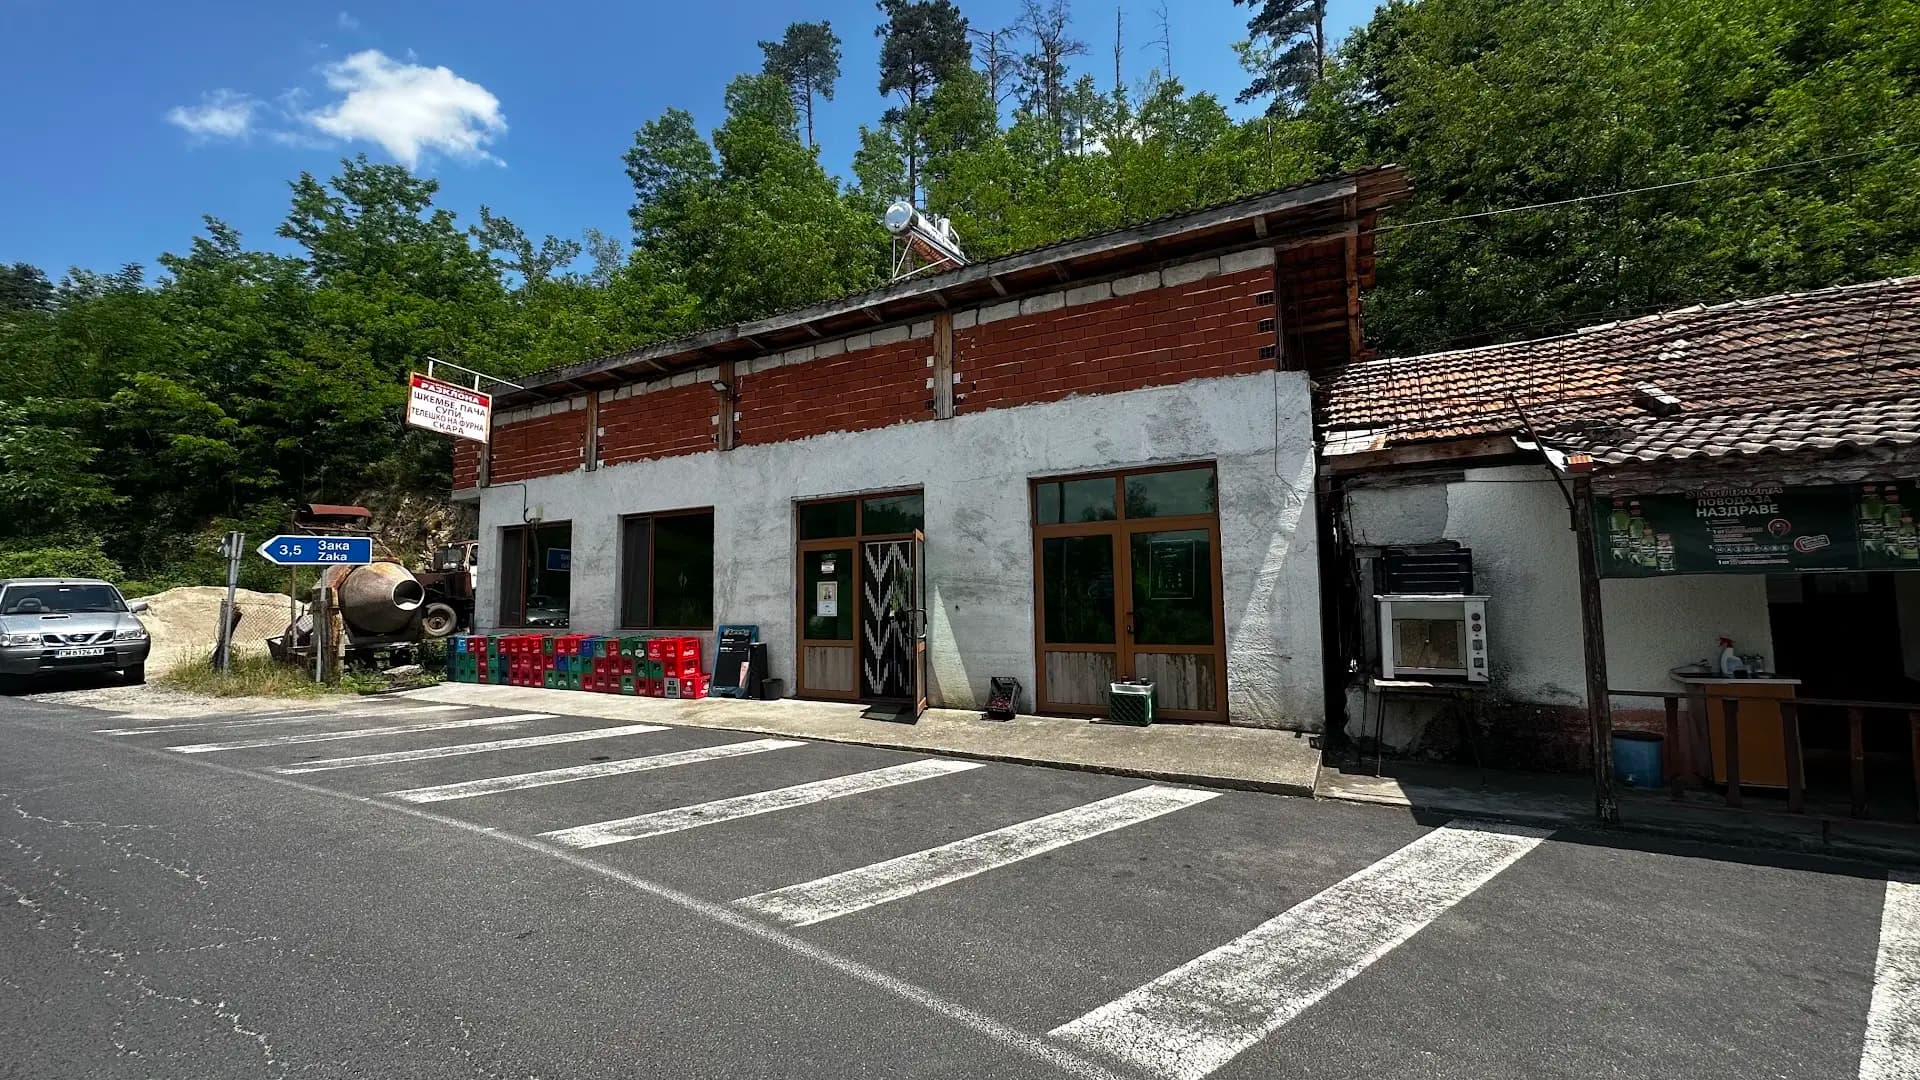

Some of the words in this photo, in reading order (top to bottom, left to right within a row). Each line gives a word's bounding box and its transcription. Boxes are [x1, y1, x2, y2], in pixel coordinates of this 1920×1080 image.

[421, 382, 480, 404] РАЗКЛОНА
[460, 404, 486, 417] ПАЧА
[411, 407, 446, 421] ТЕЛЕШКО
[447, 416, 458, 425] НА
[459, 420, 484, 432] ФУРНА
[433, 421, 464, 434] СКАРА
[1698, 496, 1753, 507] ПОВОДА
[1755, 495, 1772, 504] ЗА
[1696, 504, 1780, 518] НАЗДРАВЕ
[279, 544, 302, 557] 3,5
[318, 540, 350, 551] Зака
[318, 552, 348, 561] Zaka
